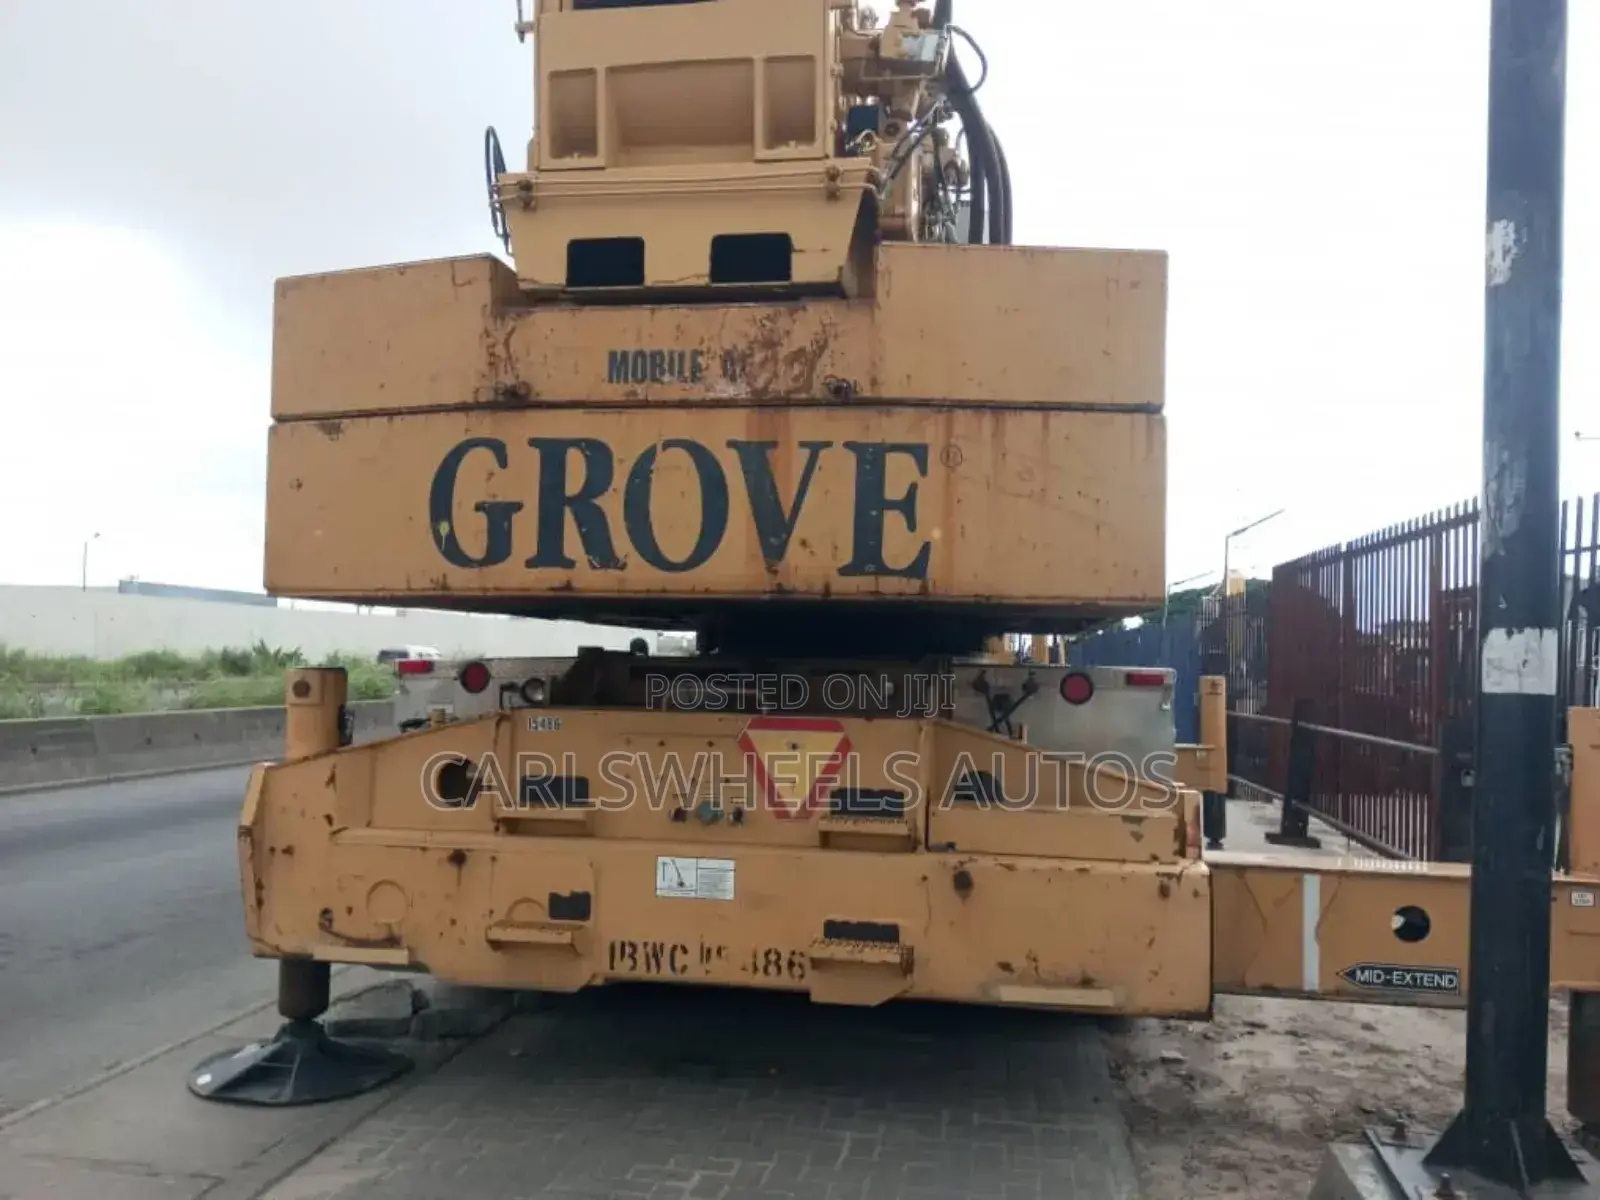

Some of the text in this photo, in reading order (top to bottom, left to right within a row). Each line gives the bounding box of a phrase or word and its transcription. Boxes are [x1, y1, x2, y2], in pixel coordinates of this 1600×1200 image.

[608, 349, 704, 384] MOBILE
[429, 435, 932, 579] GROVE
[1355, 968, 1458, 989] MID-EXTEND
